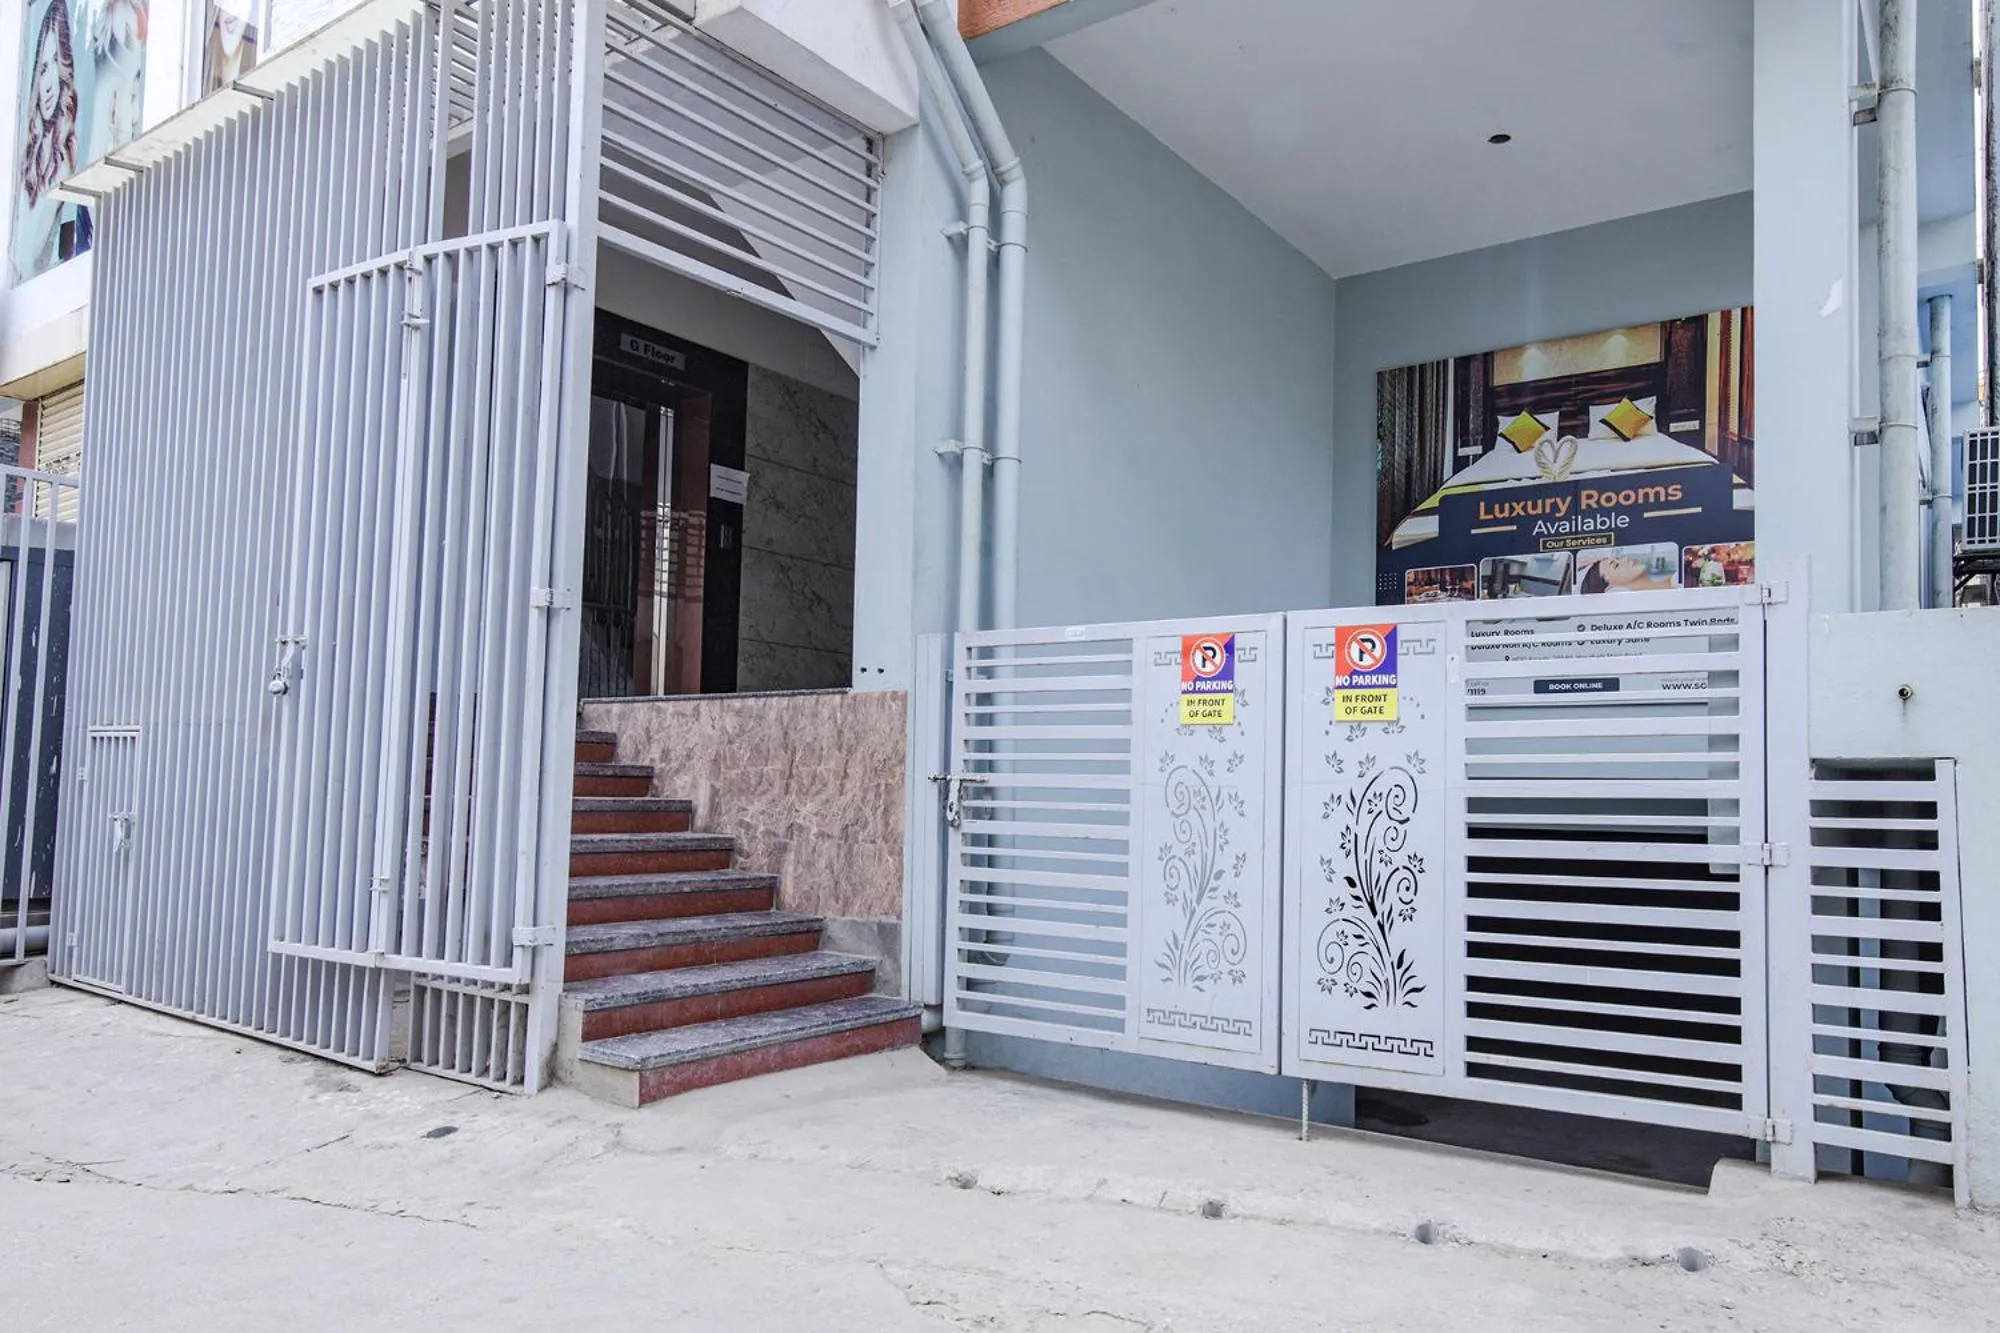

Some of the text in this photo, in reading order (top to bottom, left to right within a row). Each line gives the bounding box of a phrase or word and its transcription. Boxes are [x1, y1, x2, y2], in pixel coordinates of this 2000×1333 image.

[629, 339, 677, 364] G Floor
[1479, 484, 1684, 521] Luxury Rooms
[1532, 513, 1631, 537] Available
[1546, 536, 1608, 550] Our Services
[1590, 622, 1624, 632] Deluxe
[1625, 620, 1645, 630] A/C
[1646, 619, 1681, 628] Rooms
[1683, 617, 1708, 627] Twin
[1503, 628, 1535, 637] Rooms
[1182, 679, 1234, 693] NO PARKING
[1336, 673, 1397, 687] NO PARKING
[1573, 681, 1604, 689] ONLINE
[1187, 697, 1225, 707] IN FRONT
[1342, 693, 1388, 703] IN FRONT
[1189, 708, 1222, 718] OF GATE
[1345, 705, 1385, 716] OF GATE
